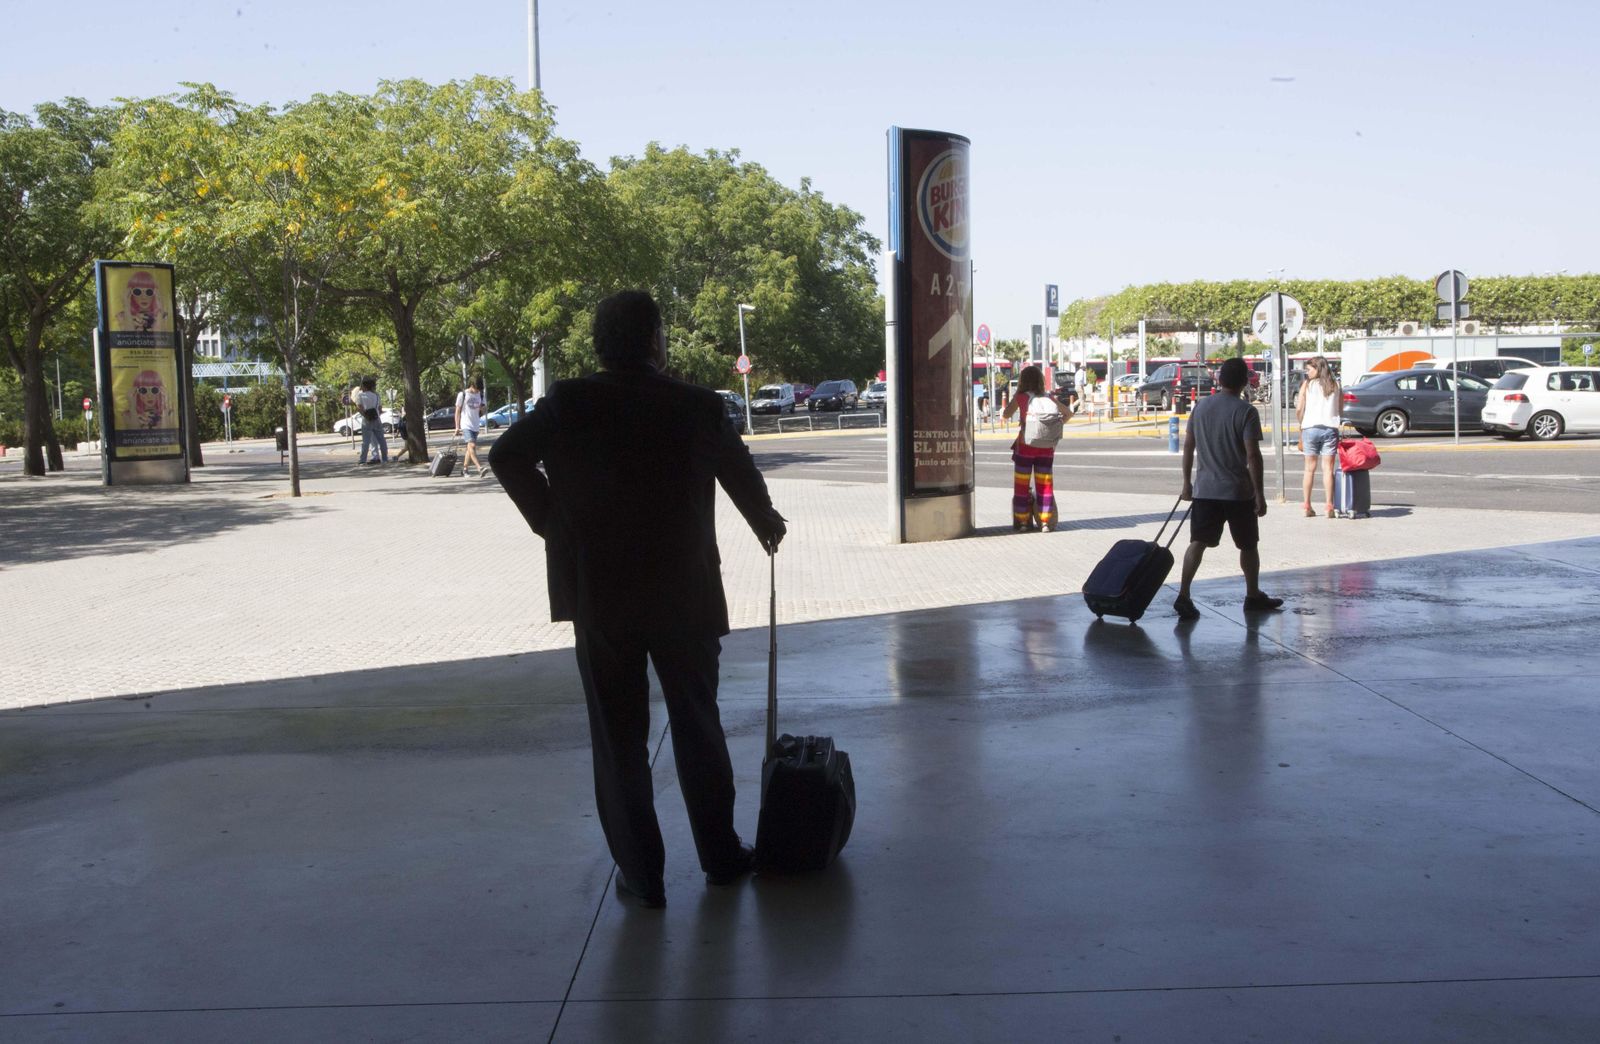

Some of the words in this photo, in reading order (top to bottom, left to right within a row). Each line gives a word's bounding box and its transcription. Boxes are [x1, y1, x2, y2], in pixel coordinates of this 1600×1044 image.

[930, 272, 942, 297] A
[913, 430, 950, 439] CENTRO
[913, 441, 932, 453] EL
